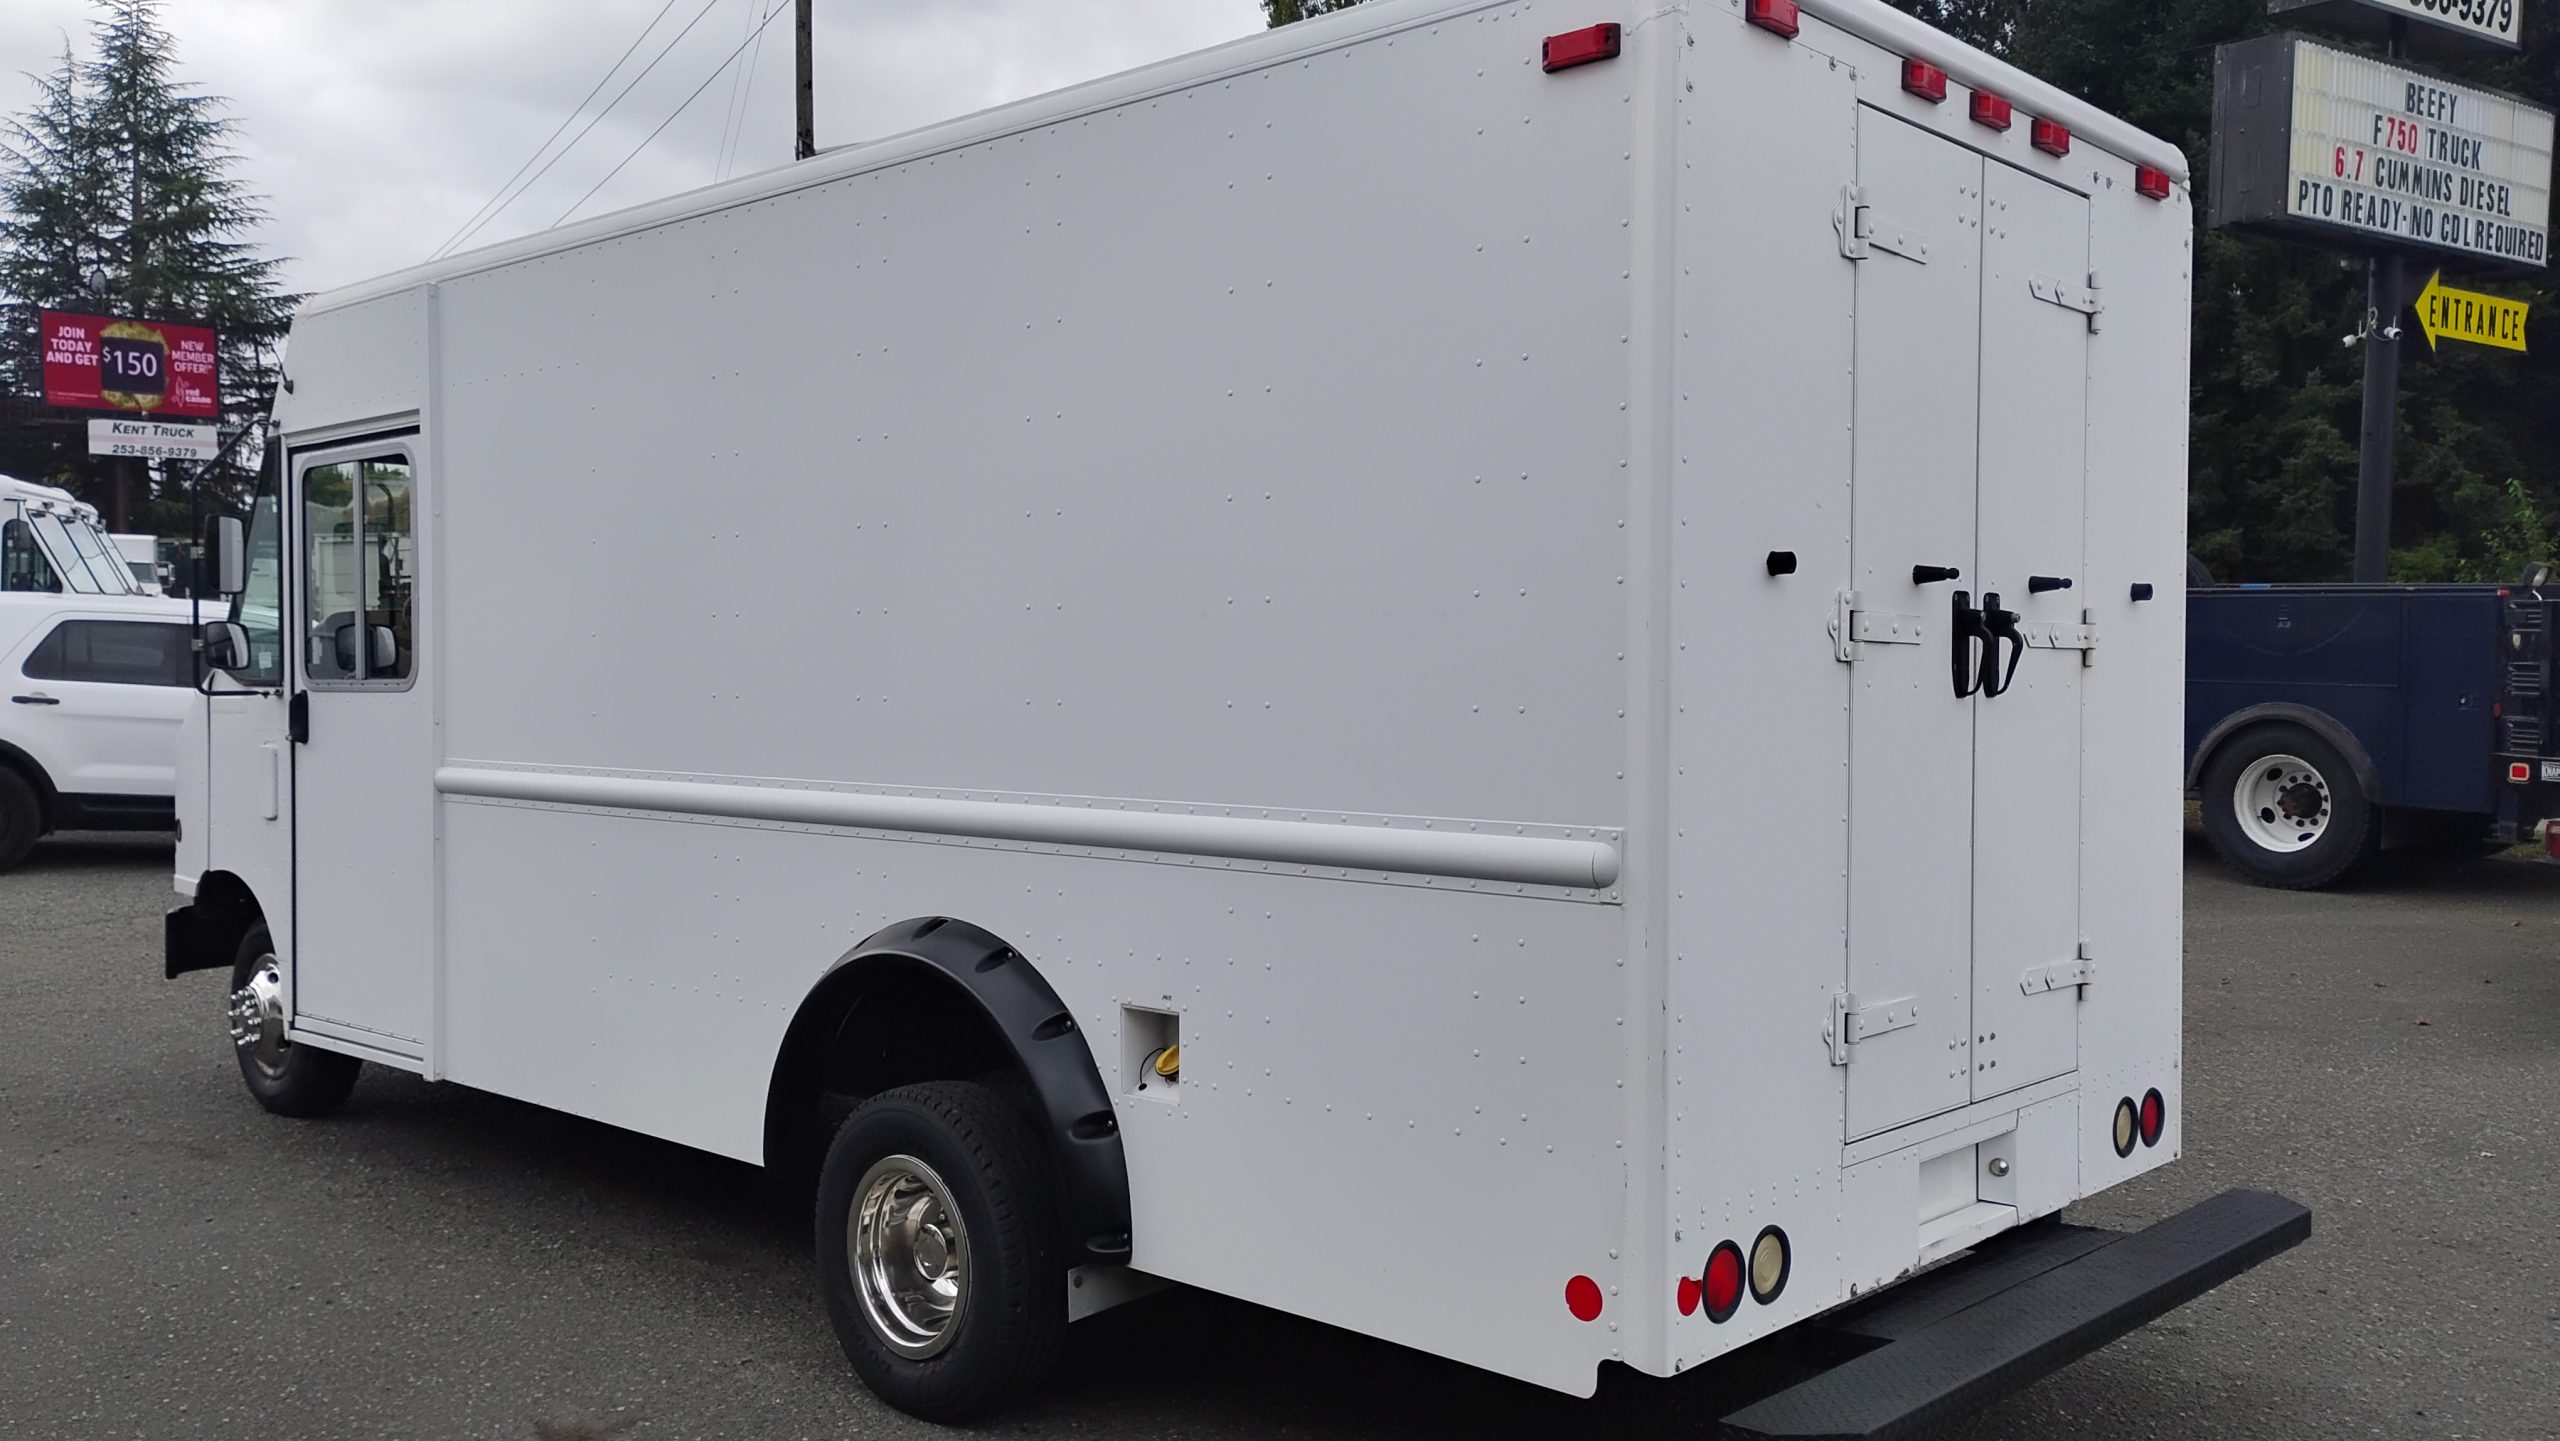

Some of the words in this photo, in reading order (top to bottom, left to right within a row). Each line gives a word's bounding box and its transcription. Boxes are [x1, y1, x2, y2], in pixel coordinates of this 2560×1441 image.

[2406, 82, 2457, 124] BEEFY
[2428, 128, 2482, 170] TRUCK
[2335, 146, 2364, 181] 6.7
[2376, 157, 2453, 202] CUMMINS
[2459, 176, 2511, 217] DIESEL
[2298, 179, 2333, 216] PTO
[2441, 213, 2470, 247] CDL
[2476, 219, 2543, 261] REQUIRED
[2429, 295, 2519, 341] ENTRANCE
[58, 326, 85, 339] JOIN
[50, 338, 92, 353] TODAY
[180, 340, 205, 352] NEW
[46, 351, 73, 364] AND
[75, 354, 98, 366] GET
[171, 350, 215, 364] MEMBER
[112, 422, 147, 435] KENT
[153, 425, 194, 438] TRUCK
[112, 444, 197, 458] 253-856-9379
